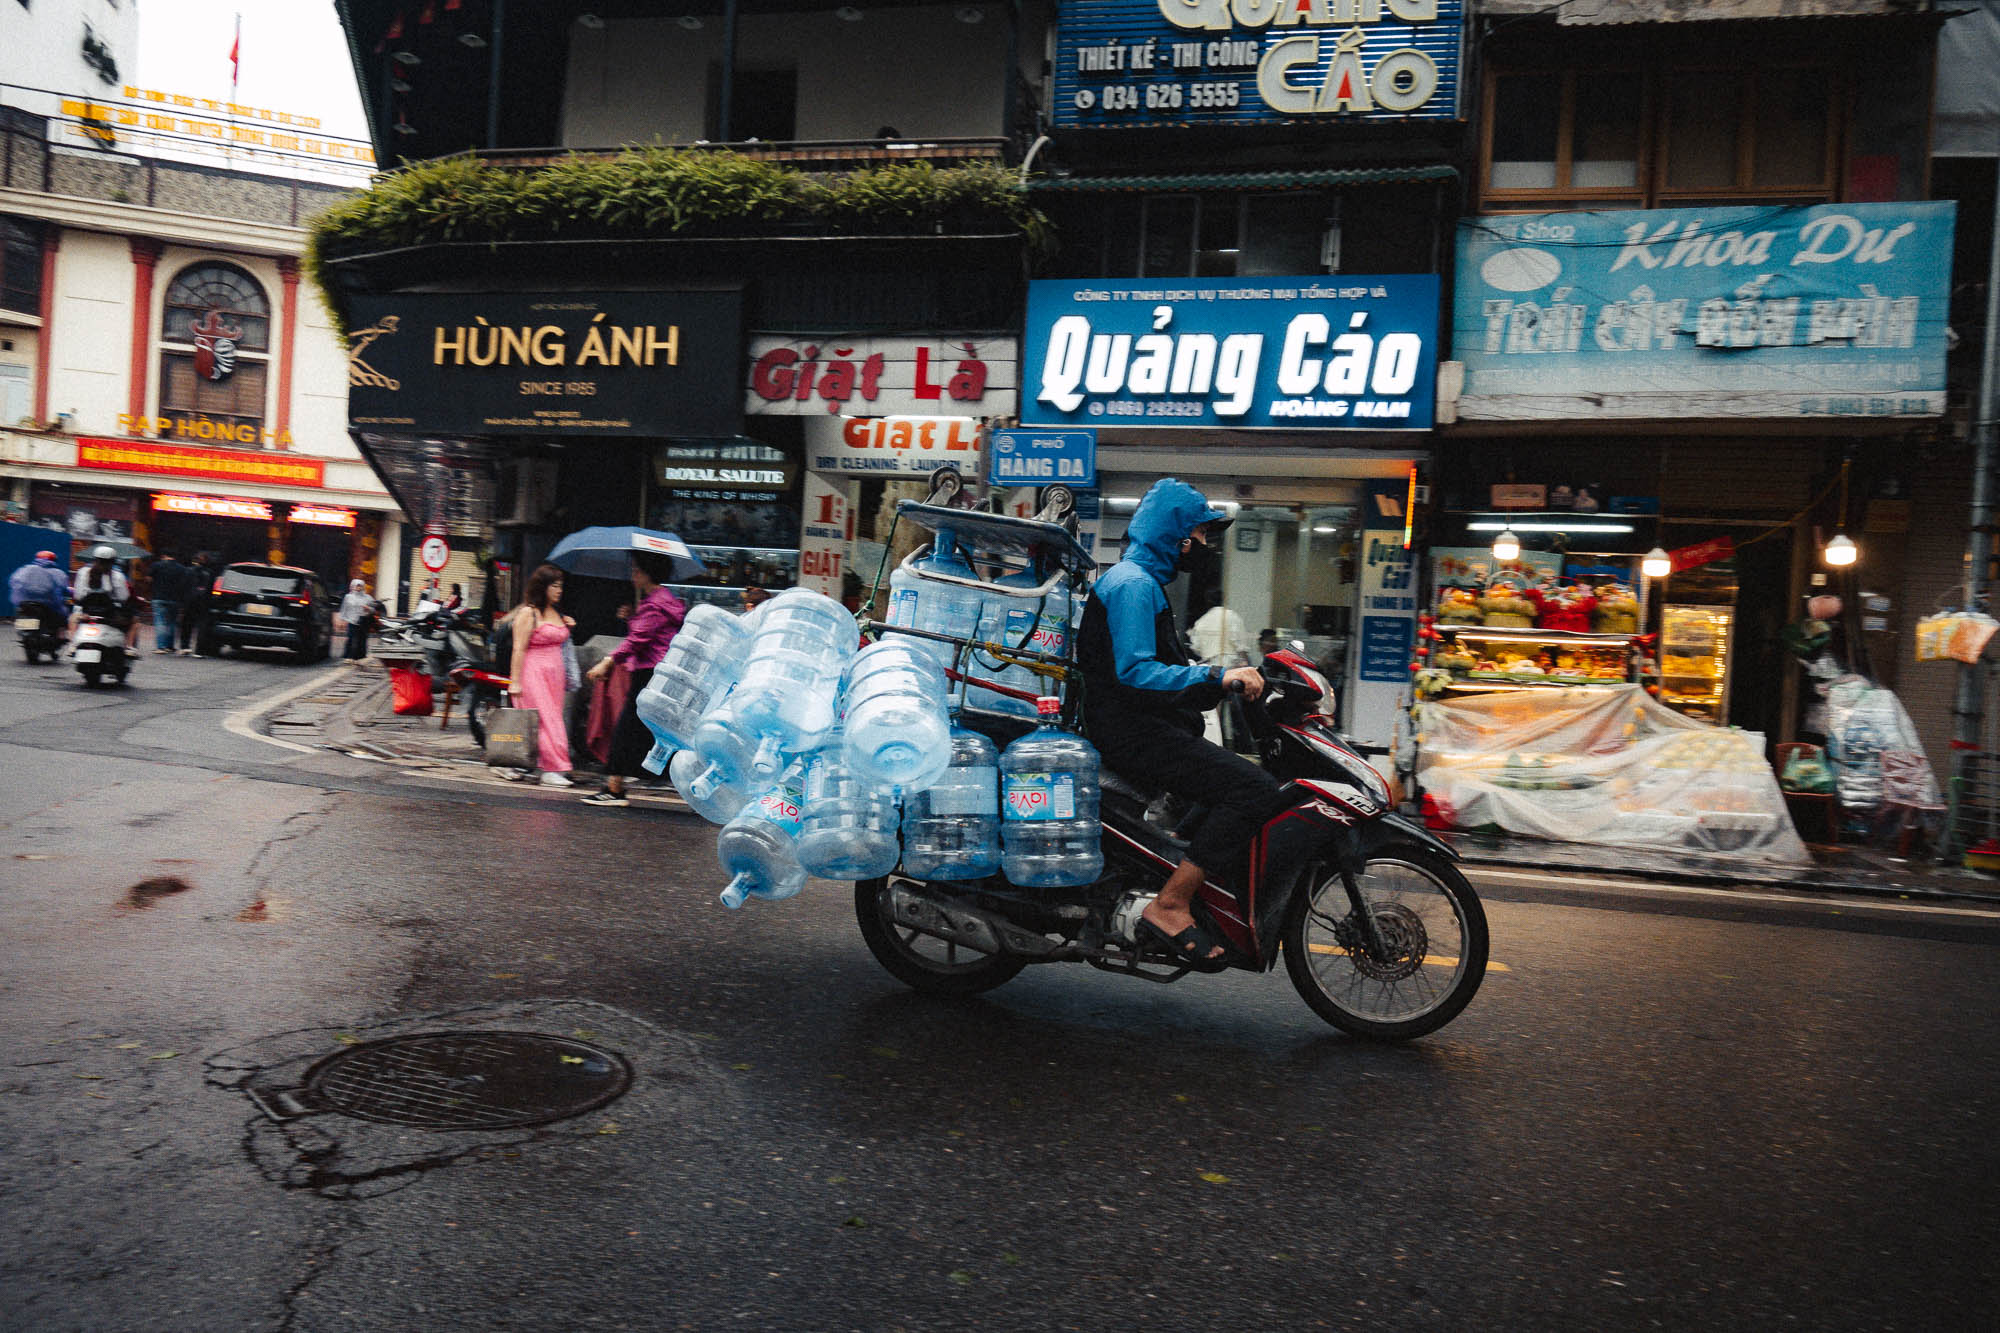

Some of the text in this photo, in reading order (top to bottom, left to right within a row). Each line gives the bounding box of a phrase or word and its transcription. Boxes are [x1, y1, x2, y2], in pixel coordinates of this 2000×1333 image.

[1077, 38, 1127, 71] THIẾT
[1131, 36, 1157, 70] KẾ
[1172, 43, 1202, 68] THI
[1206, 36, 1259, 66] CÔNG
[1256, 25, 1439, 114] CÁO
[1102, 82, 1239, 110] 034 626 5555
[1521, 221, 1576, 240] Shop
[1609, 219, 1776, 273] Khoa
[434, 313, 679, 367] HÙNG ÁNH
[1037, 305, 1422, 416] Quảng Cáo
[520, 381, 563, 396] SINCE
[753, 342, 988, 415] Giặt Là
[1269, 396, 1412, 417] HOÀNG NAM
[176, 414, 256, 443] HỒNG
[719, 469, 784, 483] SALUTE
[999, 452, 1053, 477] HÀNG
[1058, 458, 1085, 477] DA
